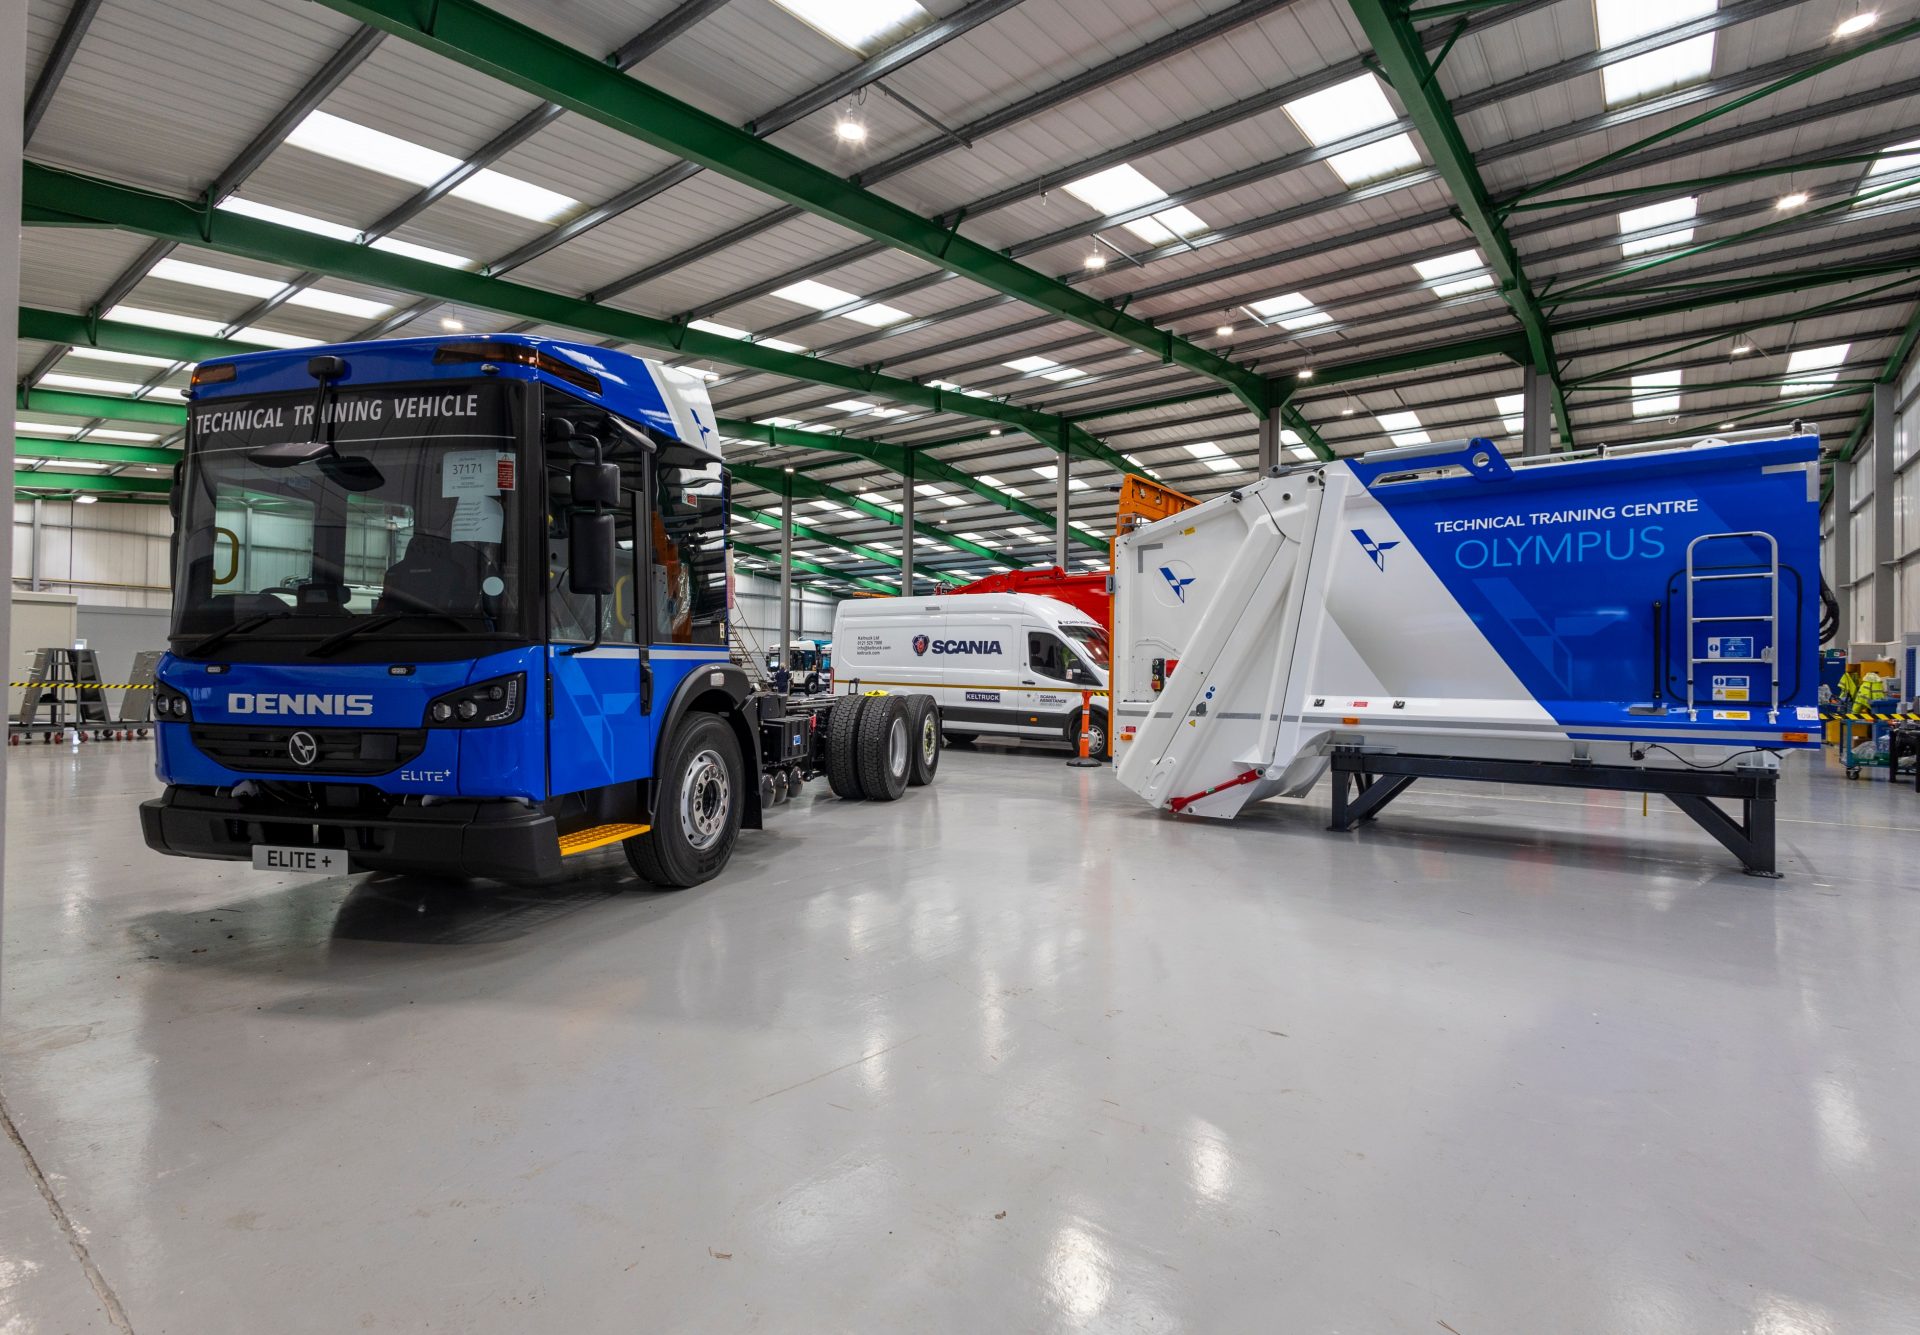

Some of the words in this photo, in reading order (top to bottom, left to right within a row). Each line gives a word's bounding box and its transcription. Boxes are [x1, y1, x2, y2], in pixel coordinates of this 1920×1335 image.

[196, 407, 284, 435] TECHNICAL
[395, 394, 478, 419] VEHICLE
[452, 463, 482, 475] 37171
[1434, 515, 1525, 533] TECHNICAL
[1529, 506, 1616, 526] TRAINING
[1621, 499, 1699, 518] CENTRE
[1455, 525, 1665, 569] OLYMPUS
[931, 640, 1003, 655] SCANIA
[228, 693, 374, 716] DENNIS
[966, 693, 1000, 702] KELTRUCK
[401, 769, 451, 782] ELITE+
[267, 850, 316, 869] ELITE
